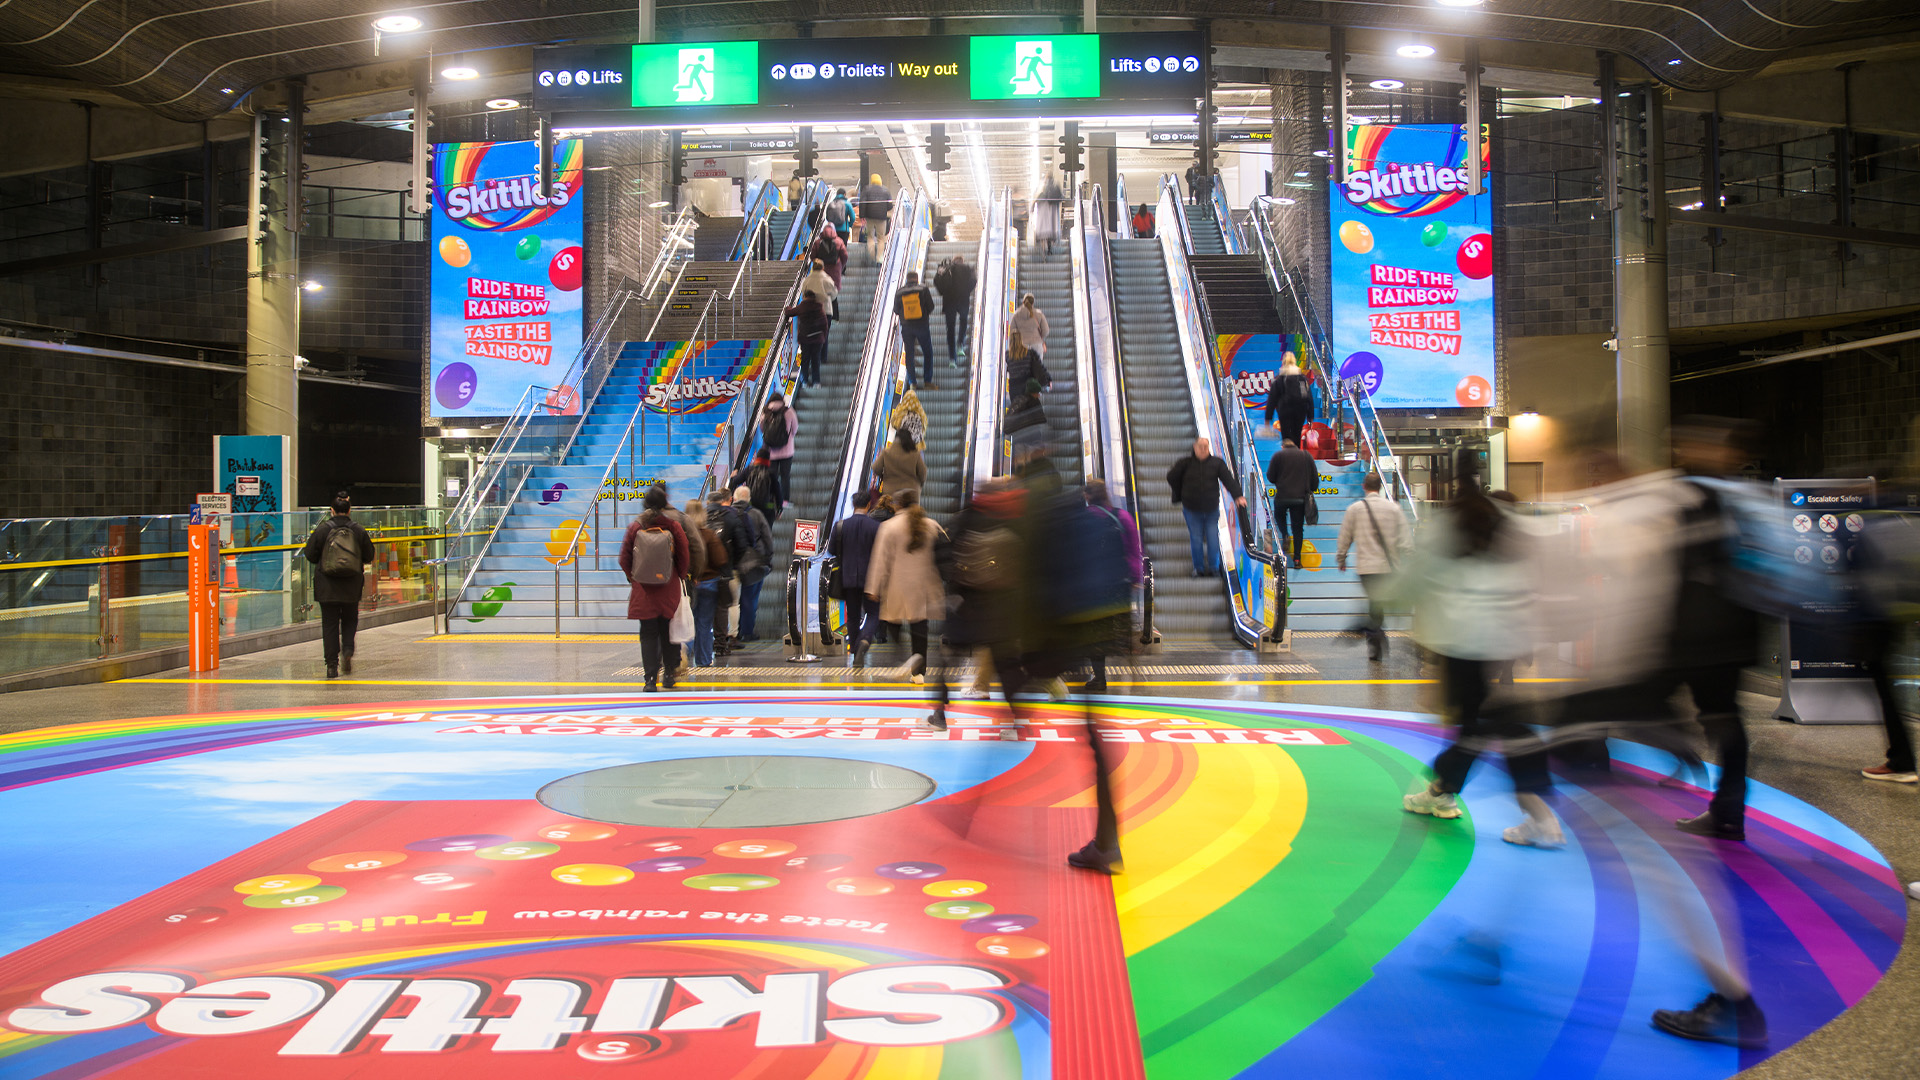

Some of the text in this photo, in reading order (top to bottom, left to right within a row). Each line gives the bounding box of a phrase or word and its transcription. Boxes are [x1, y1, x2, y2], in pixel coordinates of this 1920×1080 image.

[838, 63, 958, 79] Toilets Way out
[1110, 57, 1141, 72] Lifts
[593, 70, 622, 84] Lifts
[1250, 132, 1262, 140] Way
[1347, 162, 1468, 203] Skittles
[1465, 241, 1483, 258] S
[557, 253, 574, 270] S
[1375, 265, 1453, 286] RIDE THE
[471, 278, 545, 298] RIDE THE
[1371, 287, 1458, 305] RAINBOW
[467, 300, 549, 318] RAINBOW
[1368, 312, 1456, 330] TASTE THE
[465, 323, 547, 340] TASTE THE
[1370, 330, 1457, 355] RAINBOW
[465, 342, 548, 365] RAINBOW
[459, 381, 471, 399] S
[644, 376, 742, 404] Skittles
[1232, 370, 1274, 396] kittl
[1467, 385, 1481, 400] S
[604, 478, 629, 486] POV:
[627, 490, 648, 501] pla
[1807, 495, 1862, 504] Escalator Safety
[355, 712, 749, 725] RAINBOW
[440, 724, 1325, 745] RIDE THE RAINBOW
[291, 910, 488, 934] Fruits
[513, 909, 889, 934] Taste the rainbow
[8, 964, 1005, 1061] Skittles
